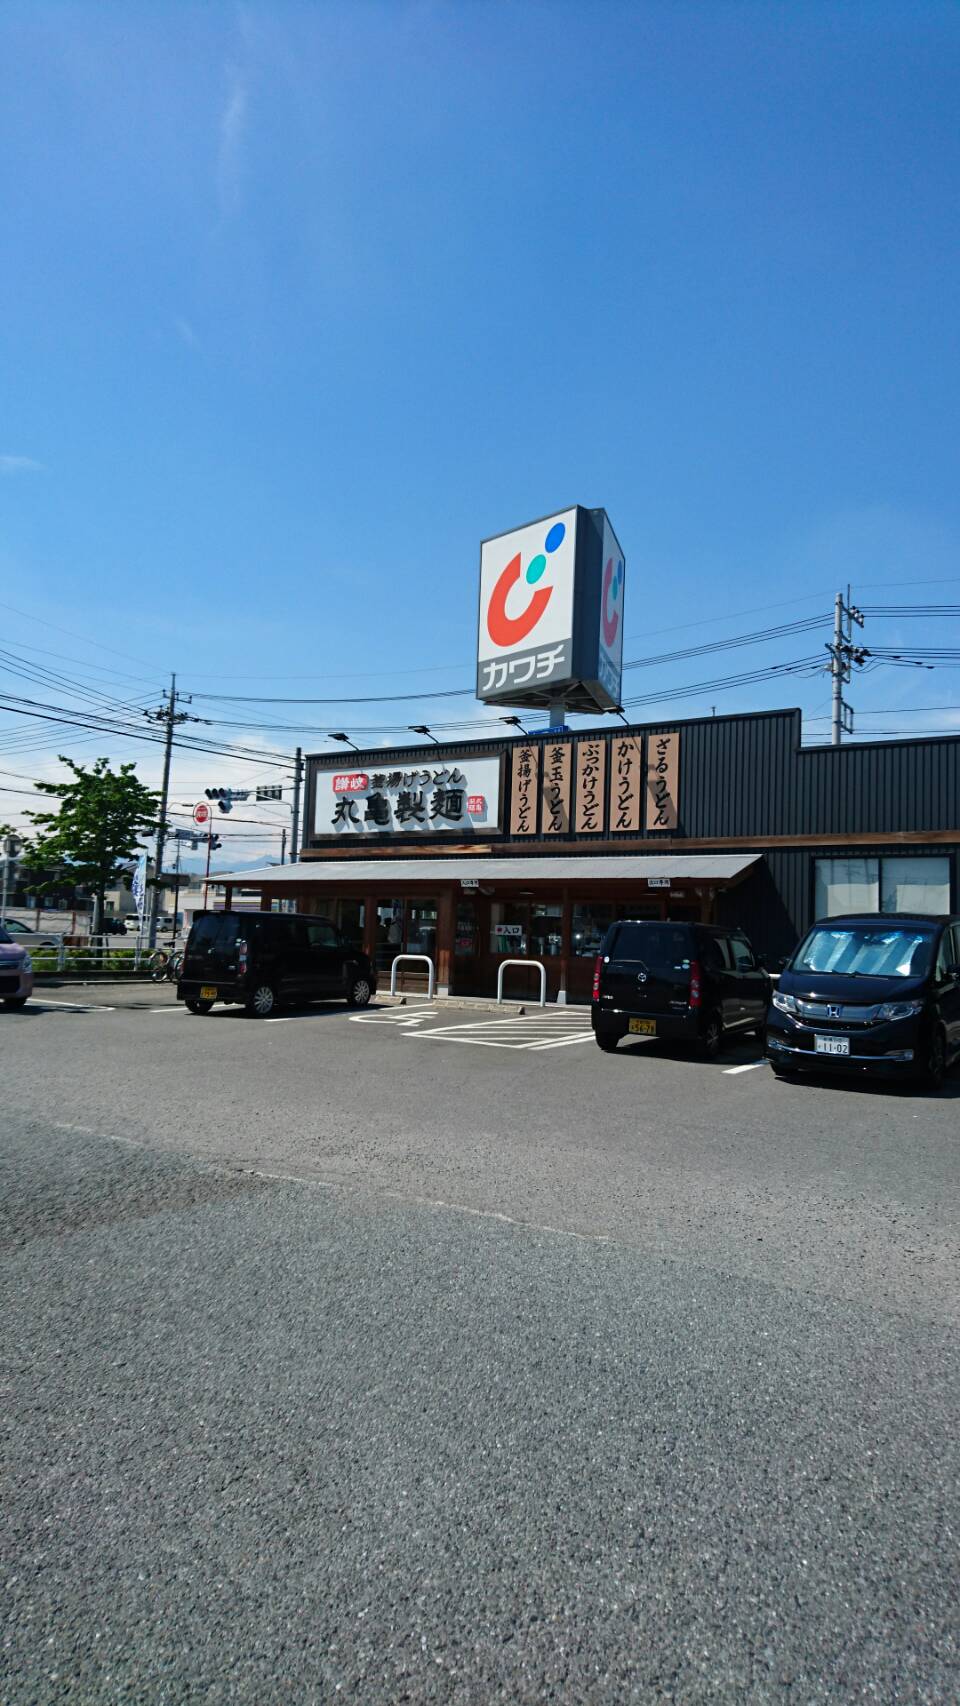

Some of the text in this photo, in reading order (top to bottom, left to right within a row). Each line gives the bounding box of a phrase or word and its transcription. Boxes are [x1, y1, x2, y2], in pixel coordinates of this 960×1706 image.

[482, 644, 566, 692] カワチ
[331, 788, 466, 826] 丸亀製麺
[517, 749, 533, 833] 釜揚げうどん
[548, 746, 566, 832] 釜玉うどん
[581, 744, 600, 830] ぶっかけうどん
[616, 741, 634, 829] かけうどん
[653, 738, 671, 826] ざるうどん
[503, 926, 520, 934] 入口
